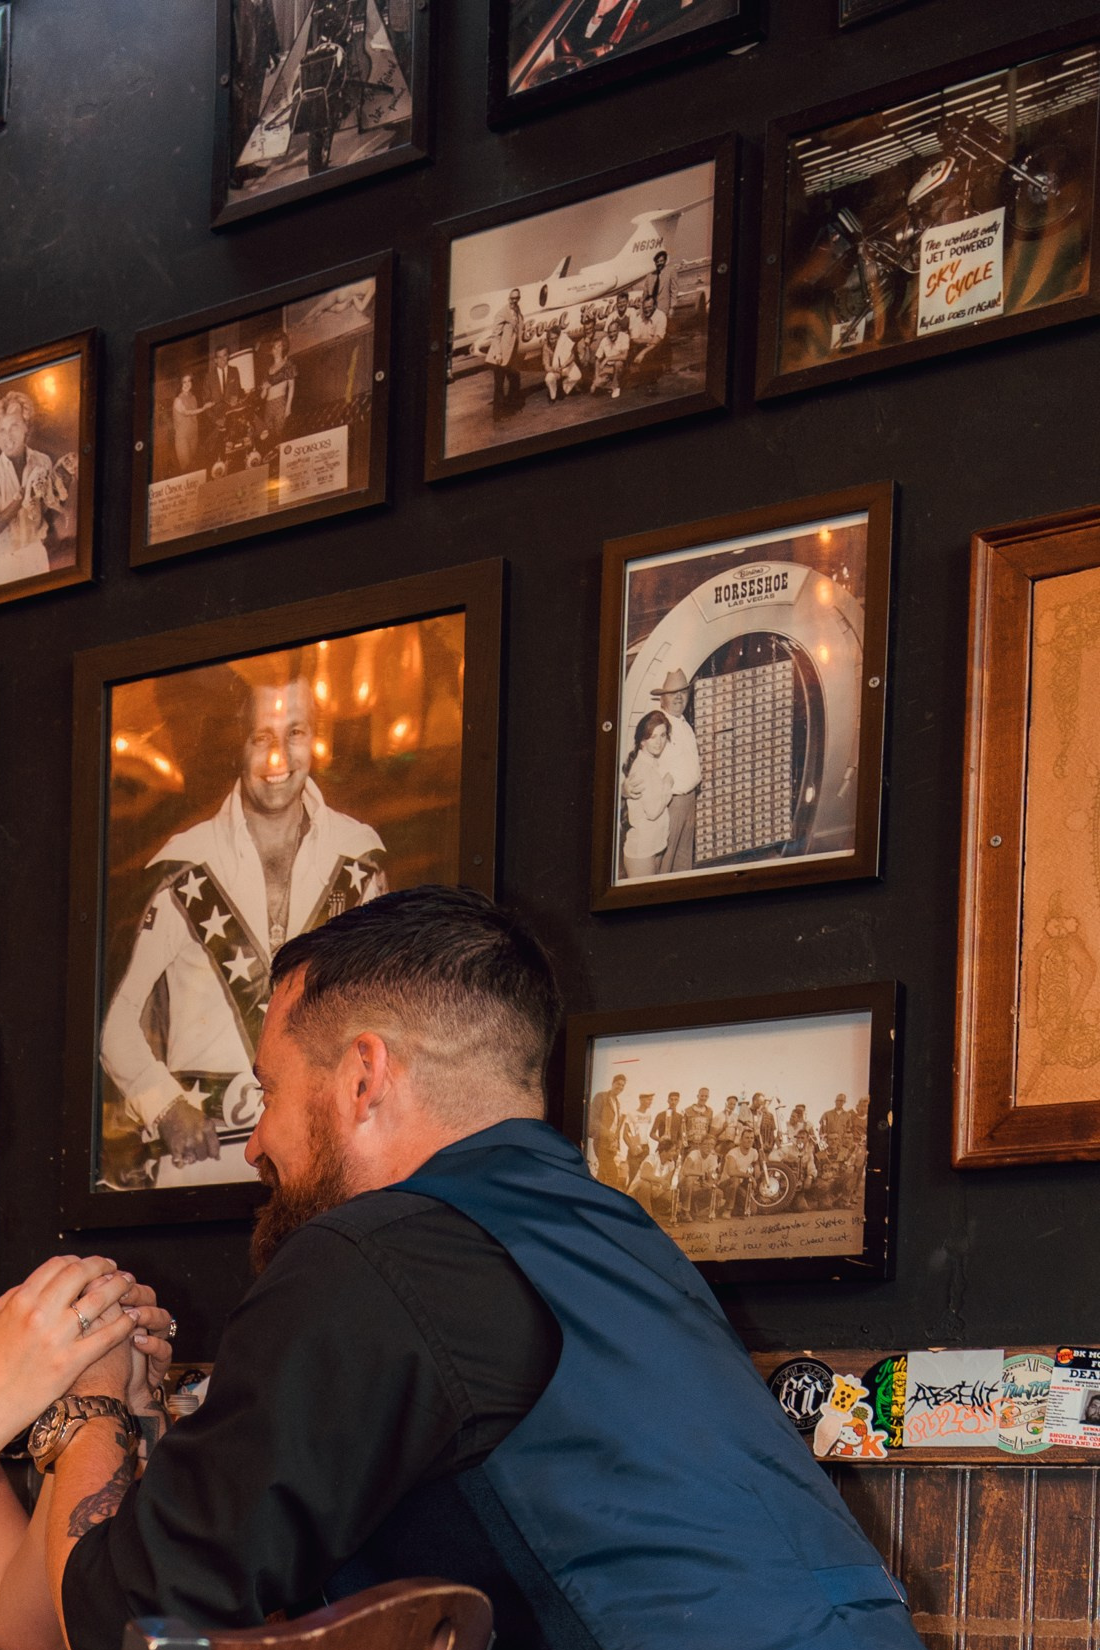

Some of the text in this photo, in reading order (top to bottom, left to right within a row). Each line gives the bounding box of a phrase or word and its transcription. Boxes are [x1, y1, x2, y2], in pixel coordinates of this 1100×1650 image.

[926, 236, 994, 264] JET POWERED
[925, 259, 962, 298] SKY
[945, 261, 994, 305] CYCLE
[947, 309, 967, 321] DOES
[714, 572, 789, 604] HORSESHOE
[727, 593, 775, 608] LAS VEGAS
[1073, 1349, 1087, 1358] BK
[1069, 1369, 1100, 1380] DEA
[1049, 1432, 1077, 1440] SHOULD
[860, 1435, 885, 1456] K
